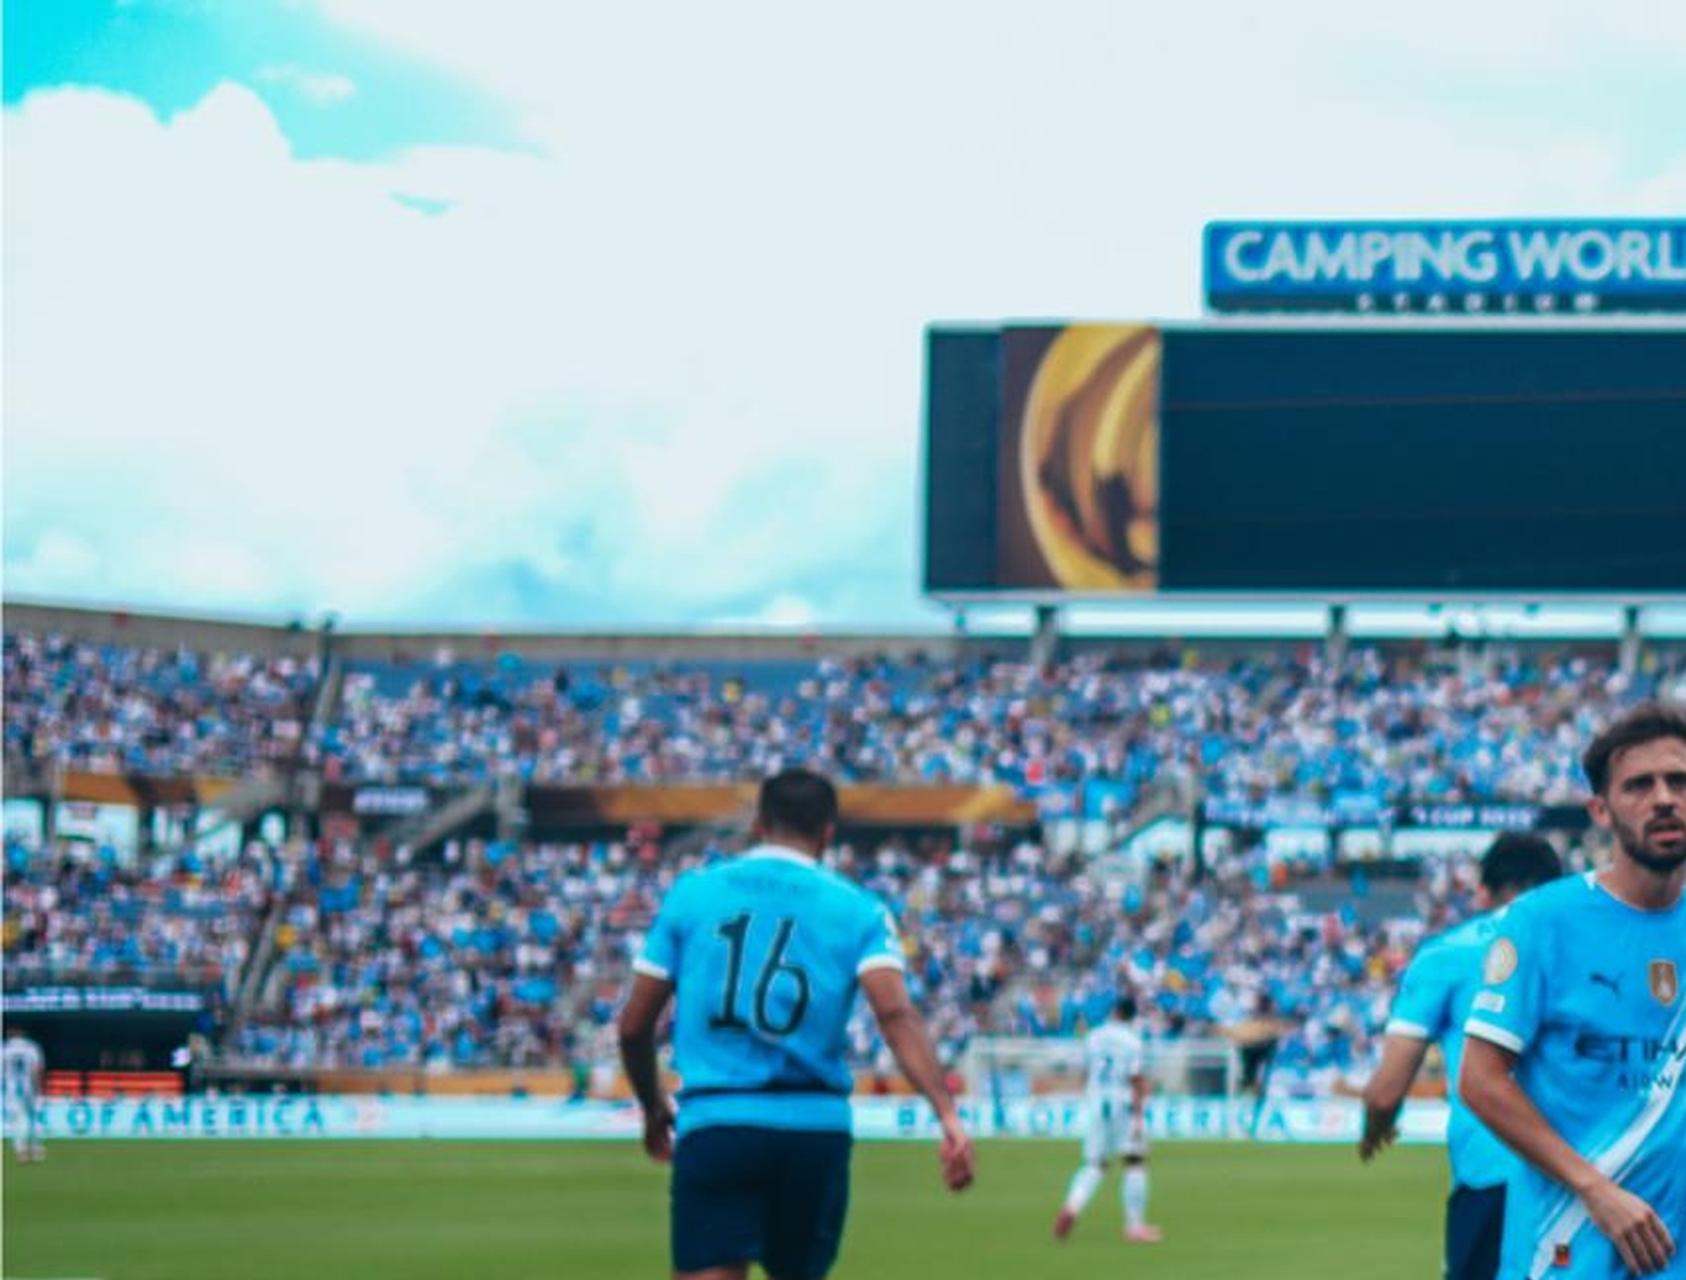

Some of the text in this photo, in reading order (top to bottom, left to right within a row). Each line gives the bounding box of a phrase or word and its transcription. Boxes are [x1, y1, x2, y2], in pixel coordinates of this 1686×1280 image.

[1224, 230, 1498, 281] CAMPING
[1355, 293, 1600, 313] STADIUM
[705, 910, 812, 1038] 16
[67, 1100, 116, 1134] OF
[132, 1100, 325, 1134] AMERICA
